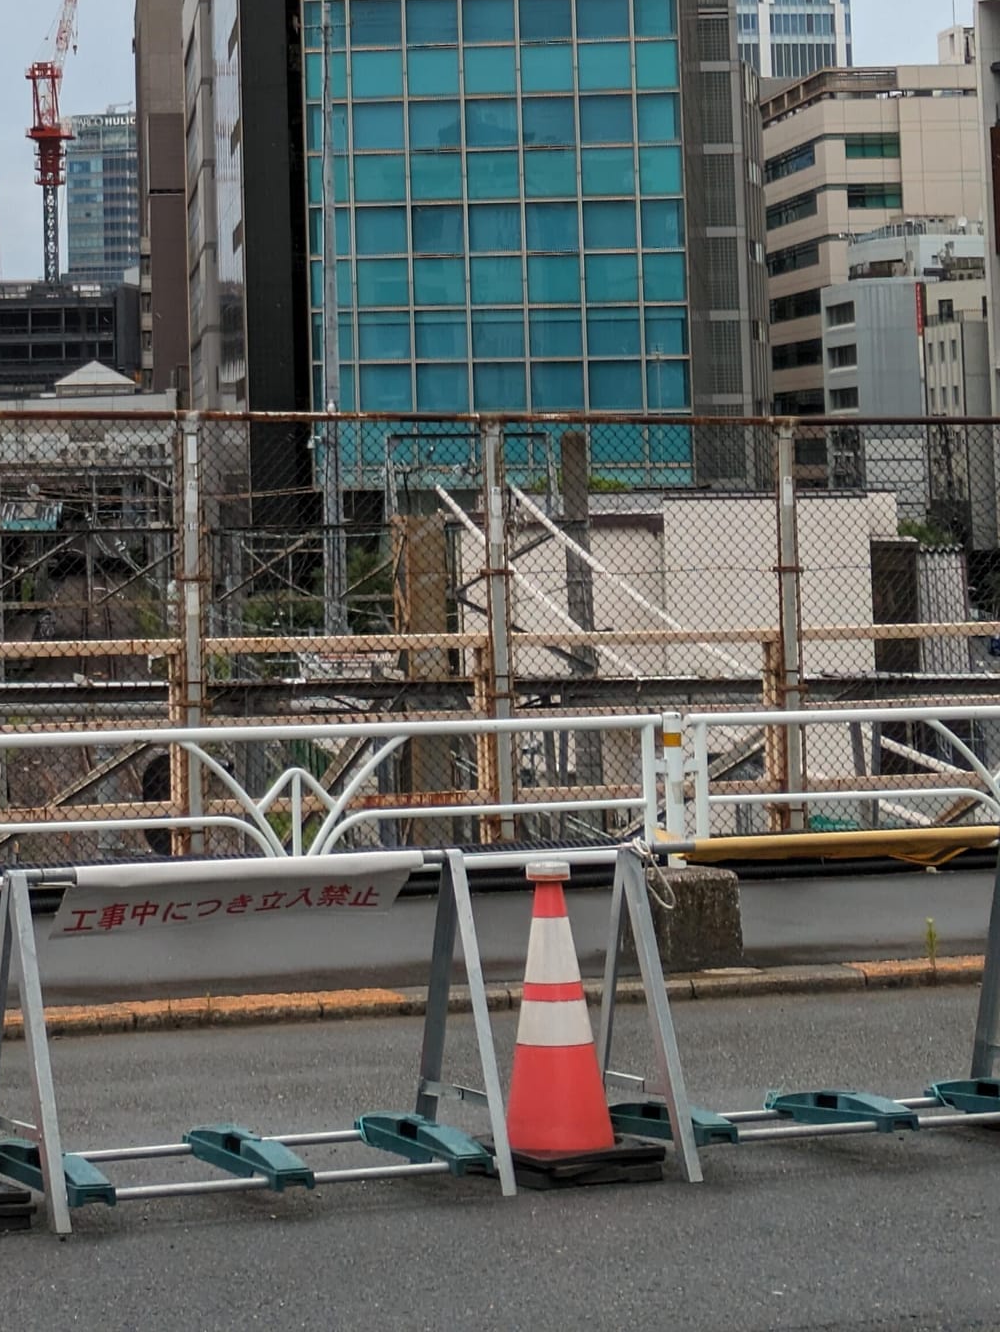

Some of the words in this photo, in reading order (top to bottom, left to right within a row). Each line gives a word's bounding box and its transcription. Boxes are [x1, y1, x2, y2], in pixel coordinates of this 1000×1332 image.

[105, 115, 136, 126] HULIC
[63, 884, 380, 931] 工事中につき立入禁止
